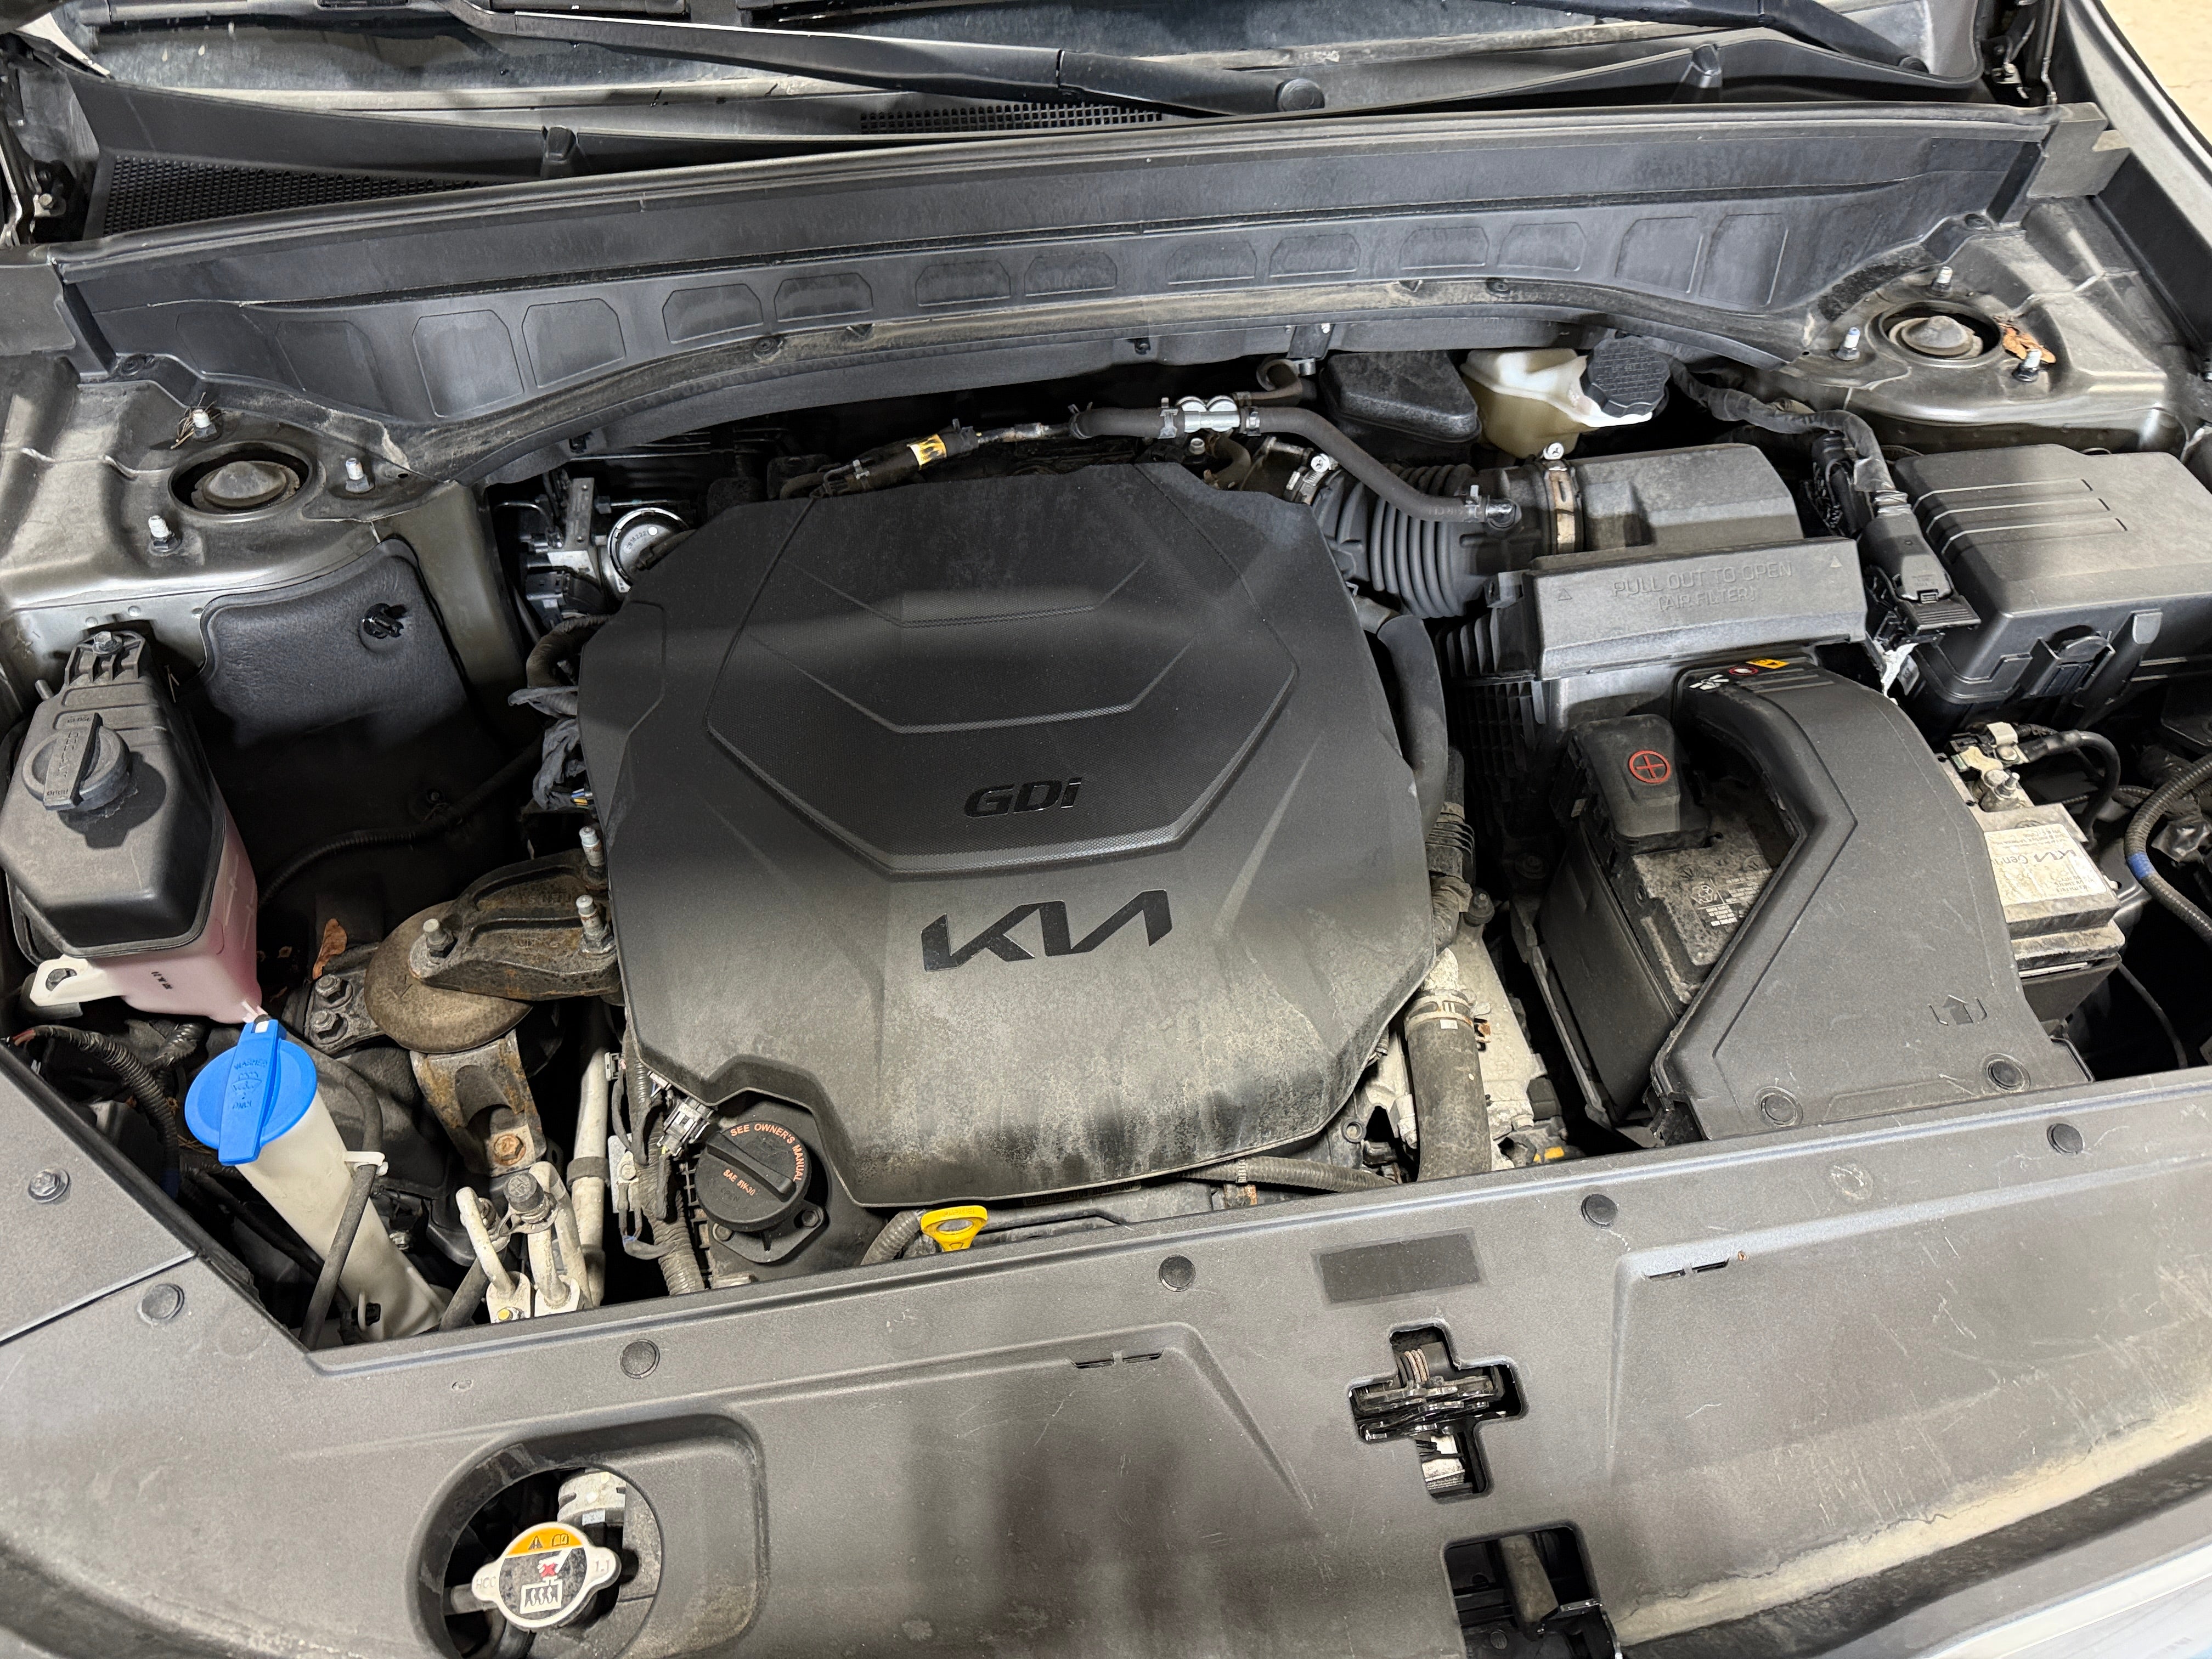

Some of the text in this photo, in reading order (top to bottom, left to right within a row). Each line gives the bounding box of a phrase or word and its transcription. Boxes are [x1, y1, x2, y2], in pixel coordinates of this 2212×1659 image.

[1613, 562, 1792, 597] PULL OUT TO OPEN
[921, 888, 1173, 973] KIA
[730, 1123, 805, 1182] SEE OWNER'S MANUAL
[723, 1169, 757, 1197] SAE 5W-30
